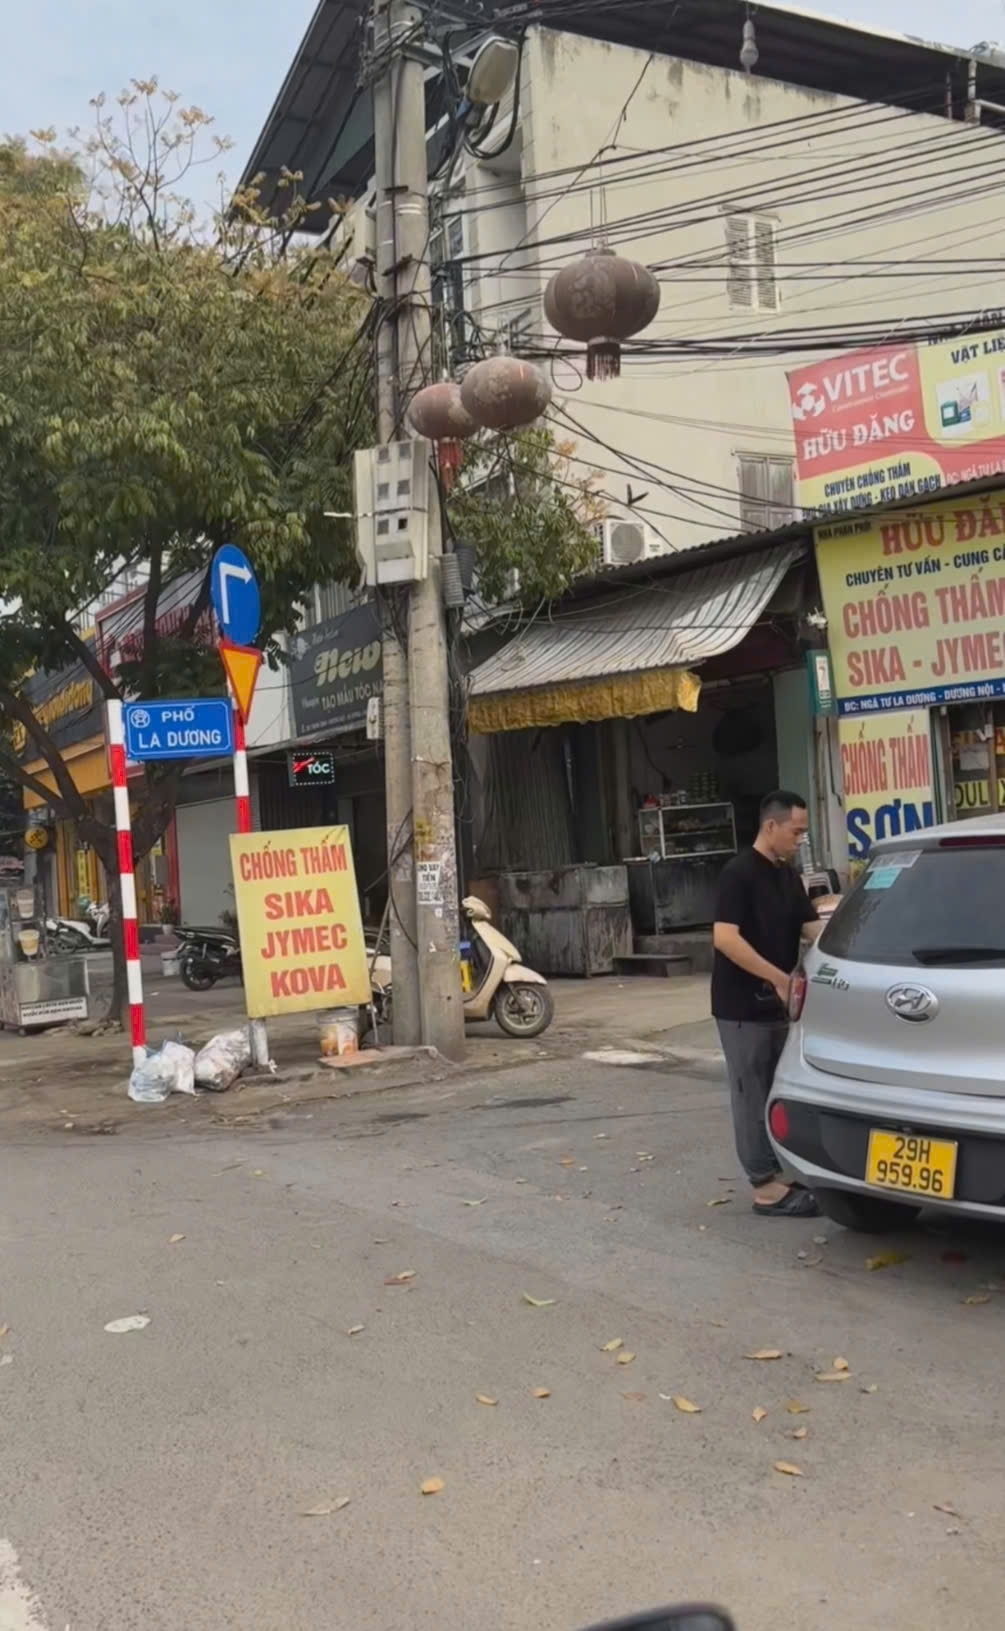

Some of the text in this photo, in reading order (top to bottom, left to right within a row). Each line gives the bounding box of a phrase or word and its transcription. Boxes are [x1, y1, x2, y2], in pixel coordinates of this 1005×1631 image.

[951, 344, 979, 364] VẬT
[822, 354, 909, 401] VITEC
[803, 409, 915, 460] HỮU ĐĂNG
[824, 459, 912, 498] CHUYÊN CHỐNG THẤM
[879, 496, 1005, 556] HỮU ĐĂ
[845, 565, 894, 587] CHUYÊN
[896, 562, 915, 578] TƯ
[914, 554, 942, 576] VẤN
[953, 549, 990, 569] CUNG
[842, 567, 1005, 639] CHỐNG THẤM
[846, 645, 907, 687] SIKA
[931, 630, 1005, 677] JYME
[161, 705, 196, 722] PHỐ
[893, 695, 905, 707] LA
[138, 729, 222, 749] LA DƯƠNG
[839, 714, 931, 797] CHỐNG THẤM
[307, 759, 331, 775] TÓC
[846, 799, 935, 861] SƠN
[239, 834, 348, 882] CHỐNG THẤM
[264, 887, 335, 921] SIKA
[260, 923, 348, 960] JYMEC
[270, 963, 347, 999] KOVA
[892, 1136, 932, 1164] 29H
[876, 1159, 945, 1193] 959.96
